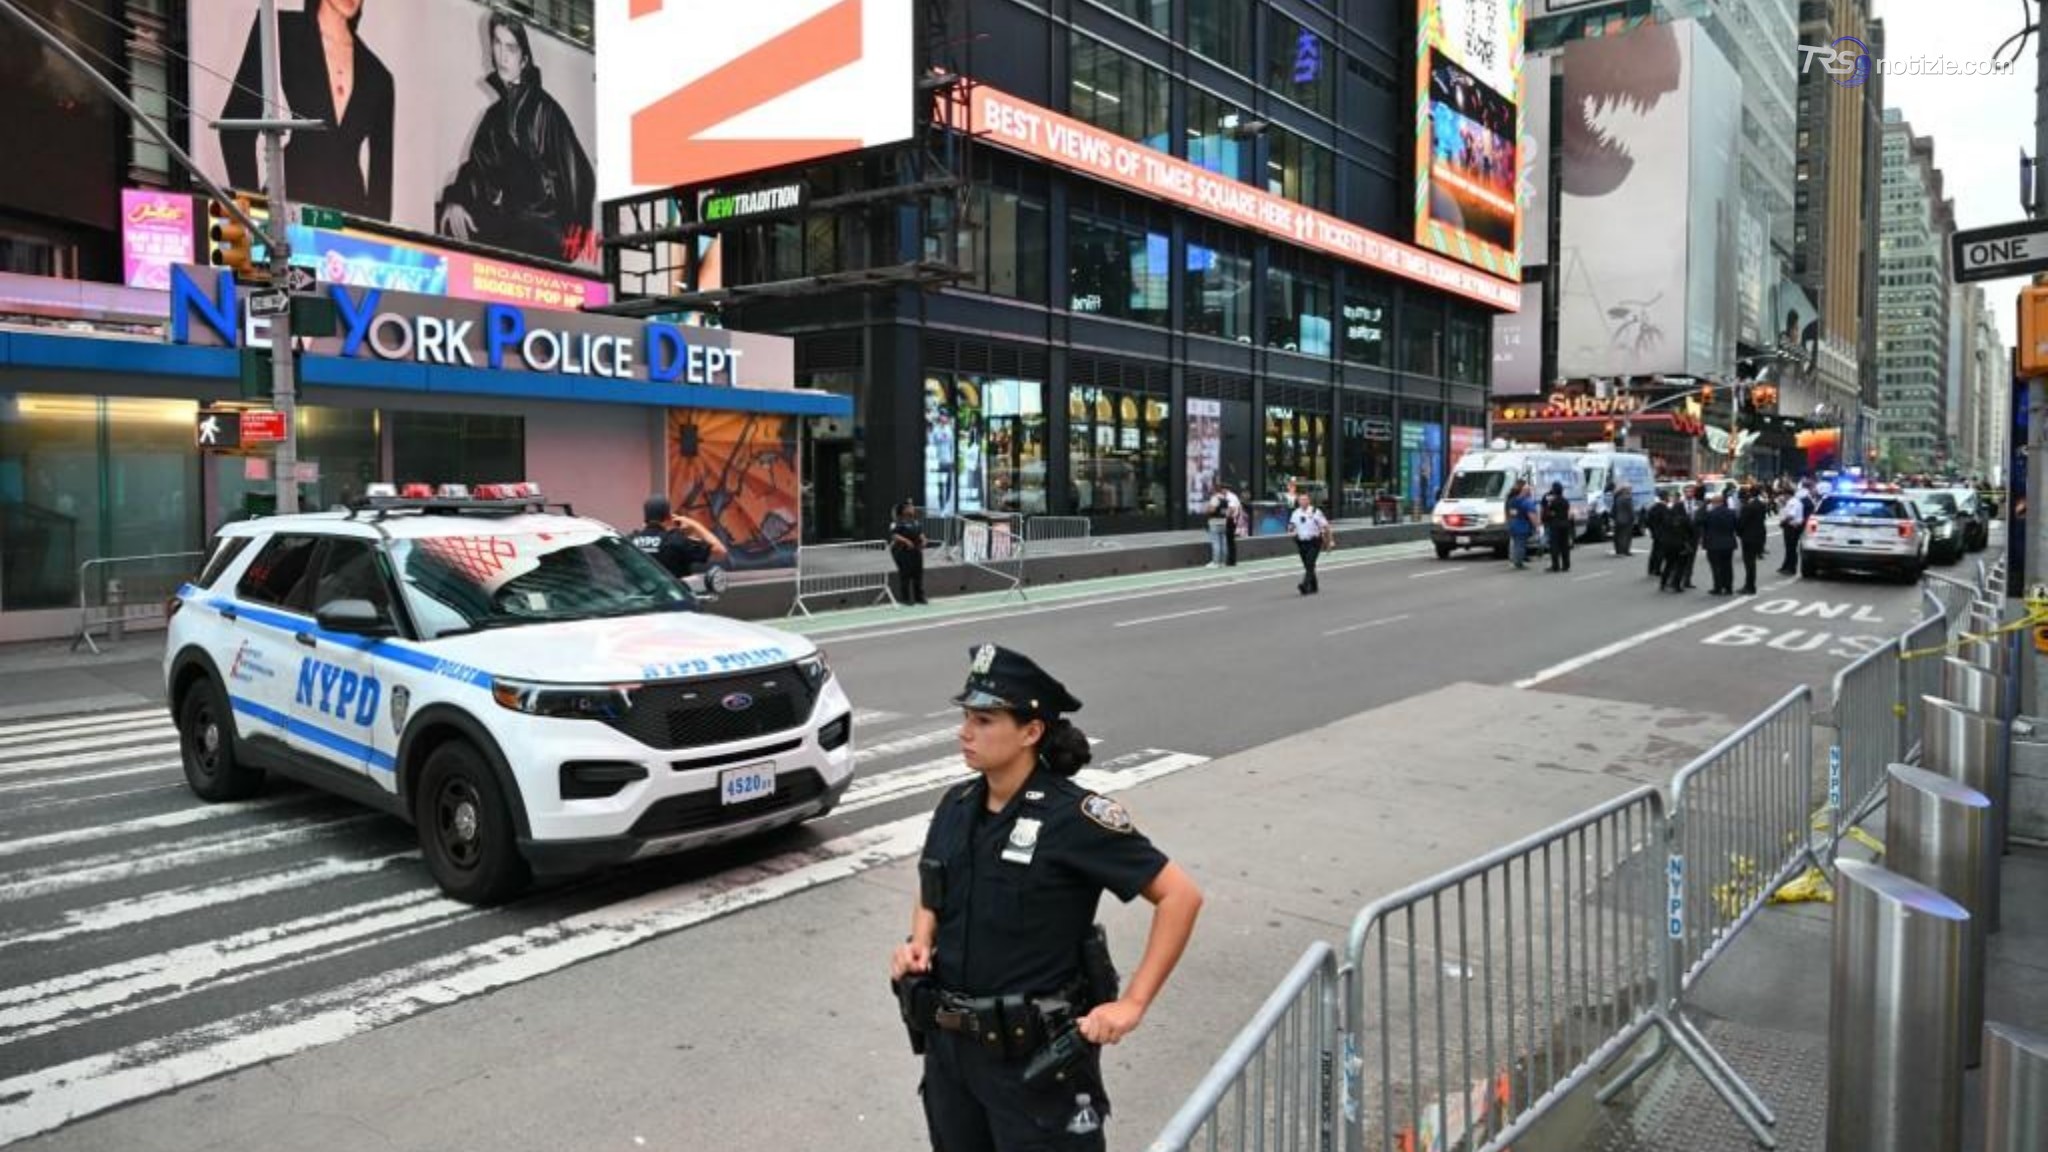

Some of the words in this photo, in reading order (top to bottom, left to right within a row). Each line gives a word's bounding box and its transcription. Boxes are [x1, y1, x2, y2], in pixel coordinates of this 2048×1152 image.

[984, 97, 1042, 145] BEST
[1045, 120, 1115, 167] VIEWS
[1115, 147, 1142, 177] OF
[1144, 156, 1195, 198] TIMES
[1196, 176, 1257, 218] SQUARE
[1260, 199, 1294, 231] HERE
[1969, 237, 2029, 266] ONE
[473, 262, 585, 294] BROADWAY'S
[535, 287, 562, 305] POP
[171, 262, 315, 351] NE
[328, 285, 474, 366] YORK
[485, 303, 634, 378] POLICE
[645, 322, 743, 387] DEPT
[1753, 598, 1885, 623] ONL
[432, 657, 480, 684] POLICE
[643, 659, 709, 680] NYPD
[713, 647, 787, 670] POLICE
[295, 656, 382, 727] NYPD
[728, 775, 761, 796] 4520
[1831, 748, 1840, 806] NYPD
[1670, 858, 1682, 935] NYPD
